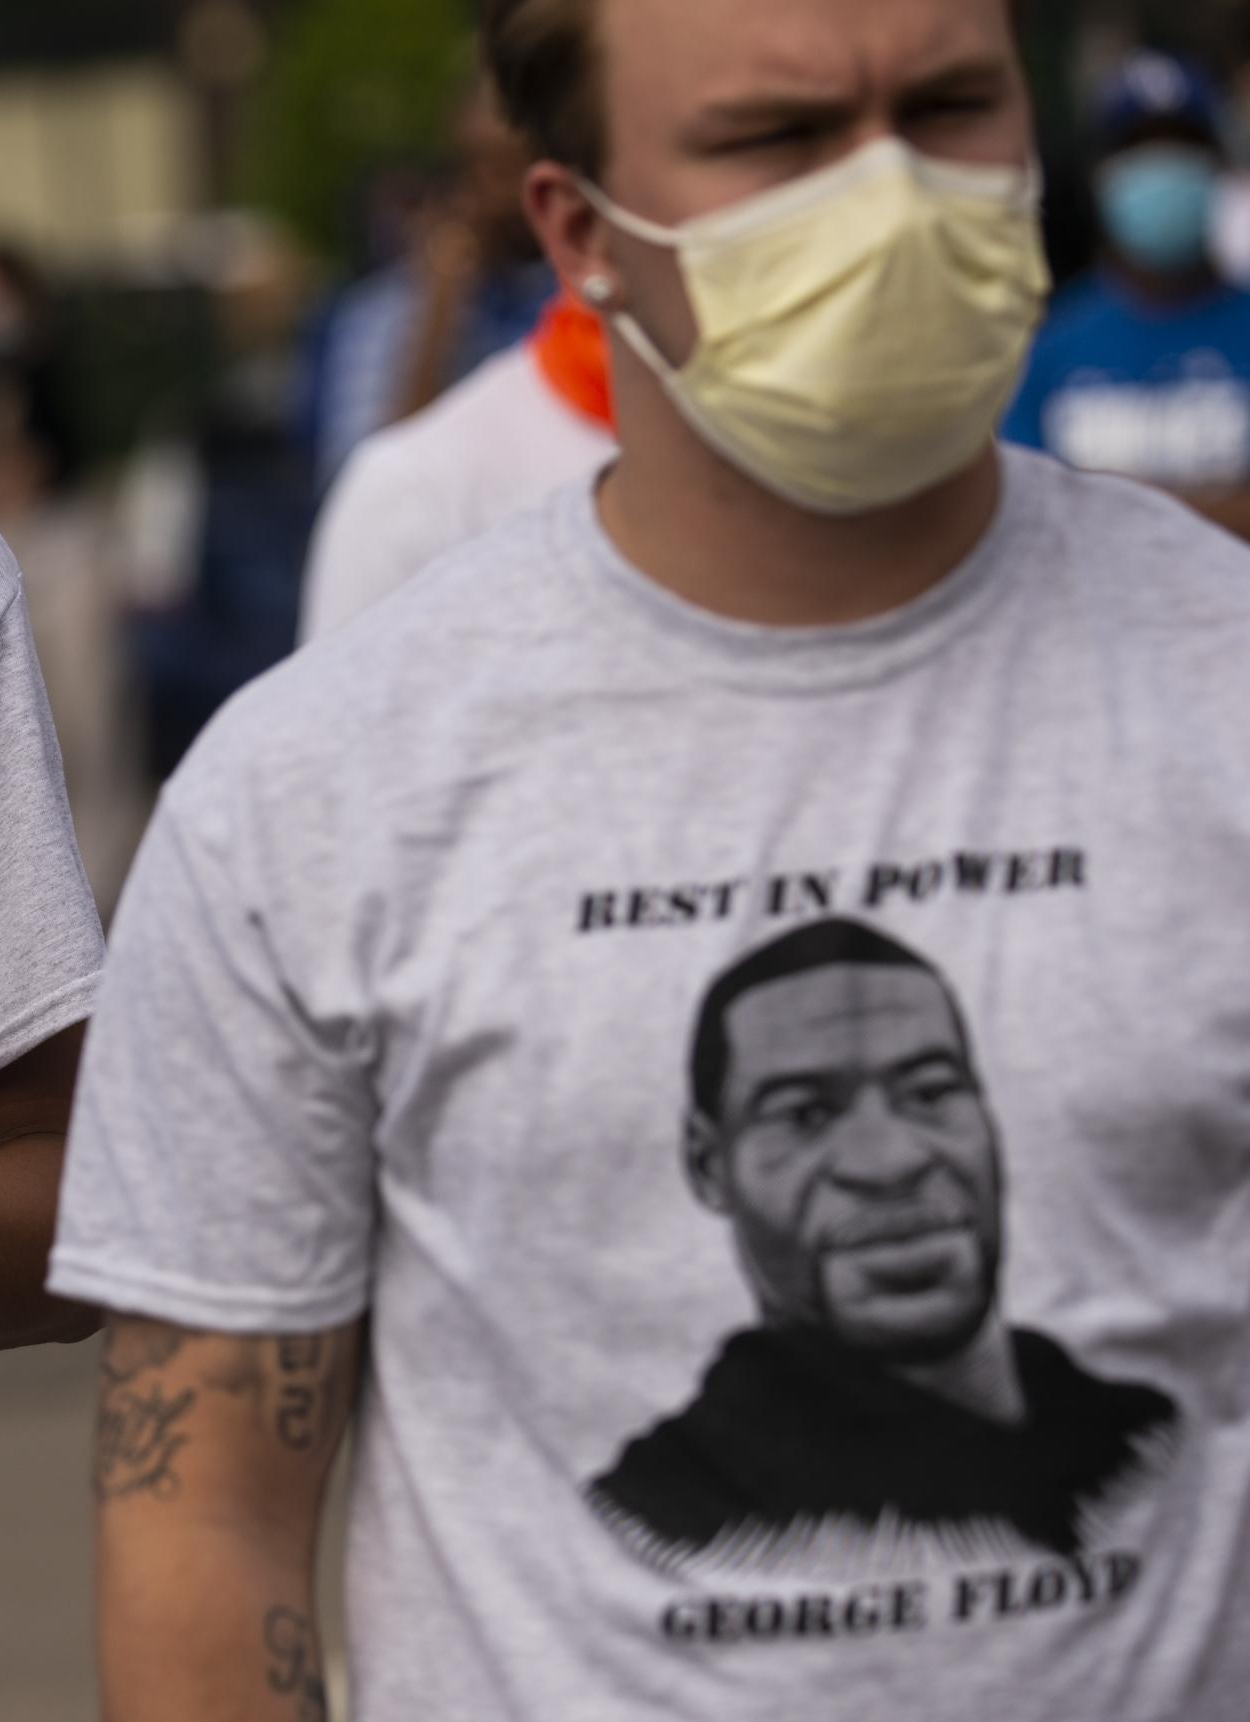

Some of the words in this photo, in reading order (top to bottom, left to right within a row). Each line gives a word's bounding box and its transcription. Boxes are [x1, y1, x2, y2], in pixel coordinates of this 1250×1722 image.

[576, 878, 746, 932] REST
[768, 872, 837, 915] IN
[862, 847, 1086, 906] POWER
[661, 1580, 930, 1642] GEORGE
[954, 1552, 1142, 1621] FLOYD
